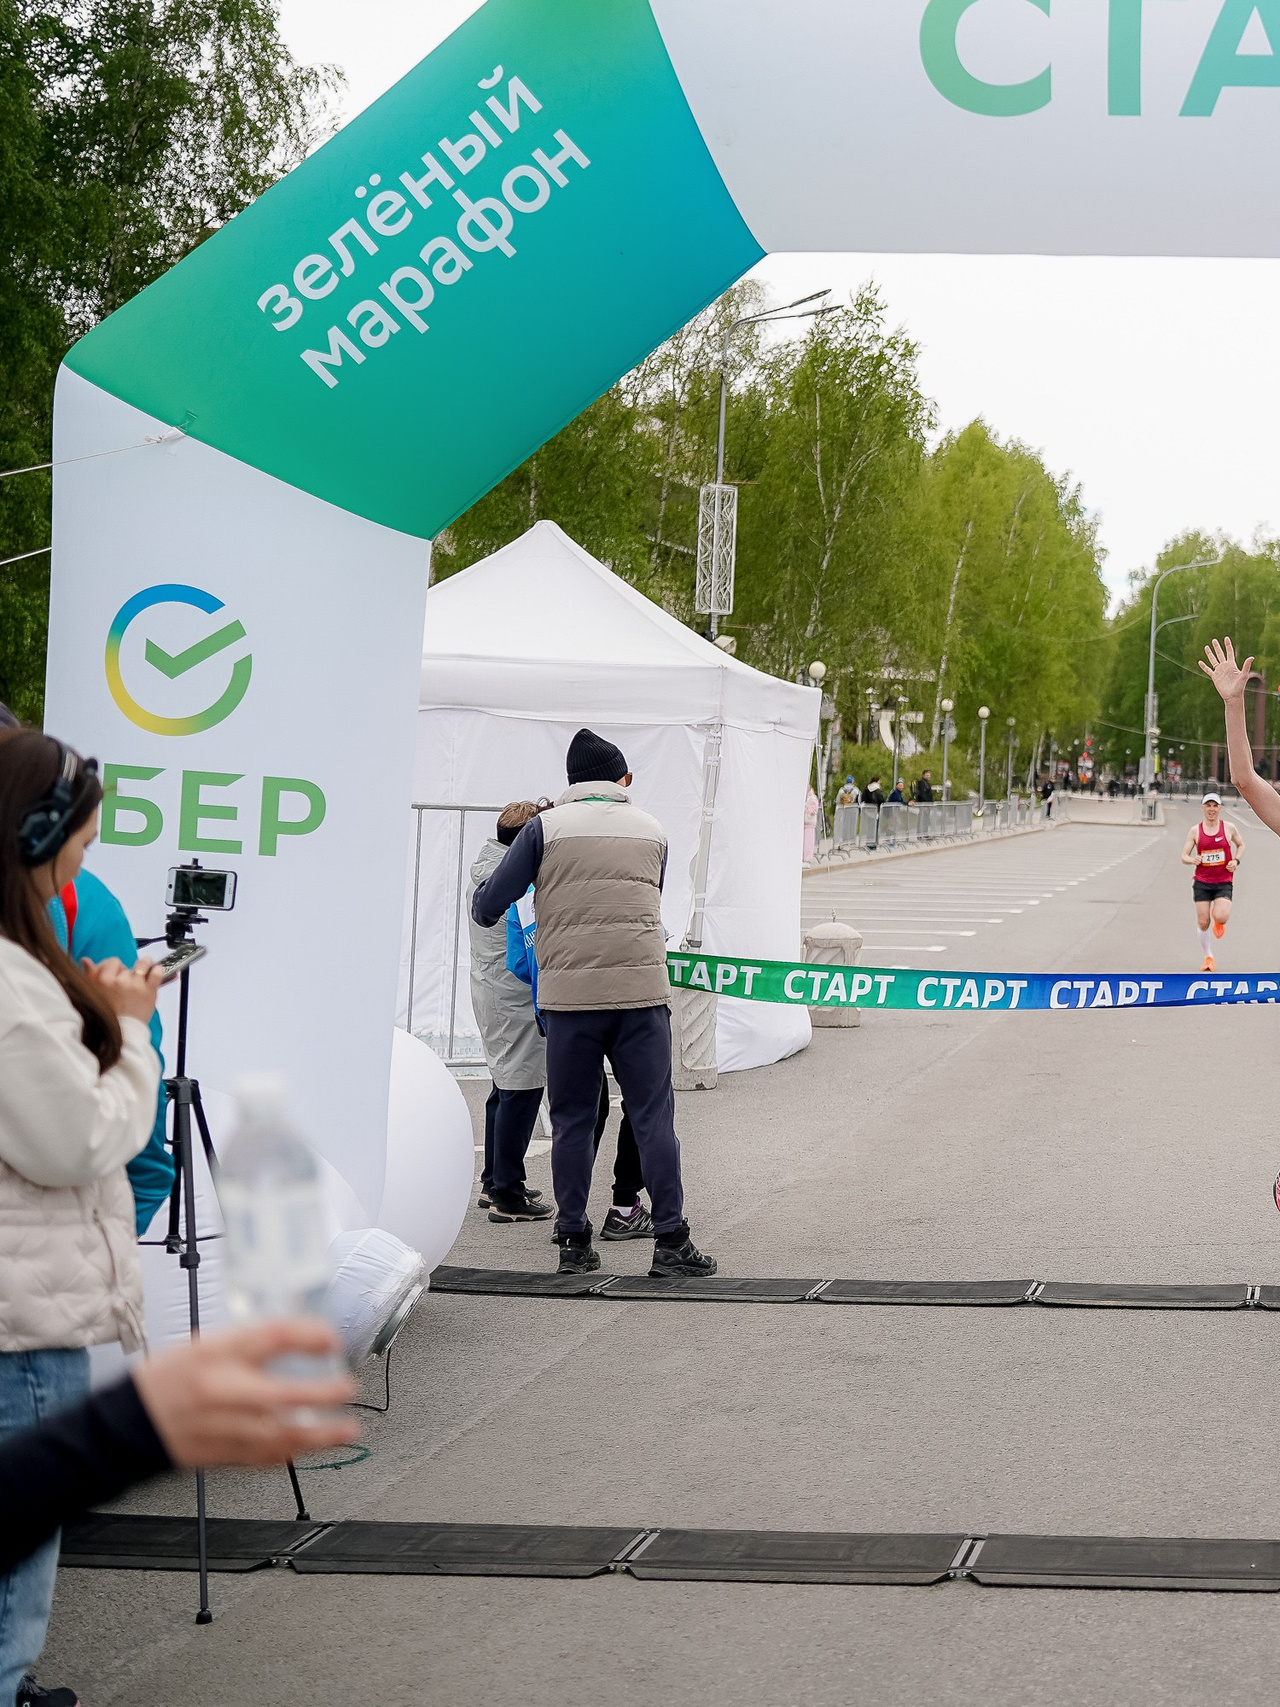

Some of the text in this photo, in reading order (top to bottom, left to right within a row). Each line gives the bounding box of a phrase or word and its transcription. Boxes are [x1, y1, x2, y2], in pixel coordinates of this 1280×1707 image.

[257, 64, 543, 331] зелёный
[300, 129, 591, 389] марафон
[100, 763, 326, 857] БЕР
[667, 959, 762, 995] ТАРТ
[783, 970, 895, 1004] СТАРТ
[916, 977, 1027, 1009] СТАРТ
[1049, 980, 1163, 1009] СТАРТ
